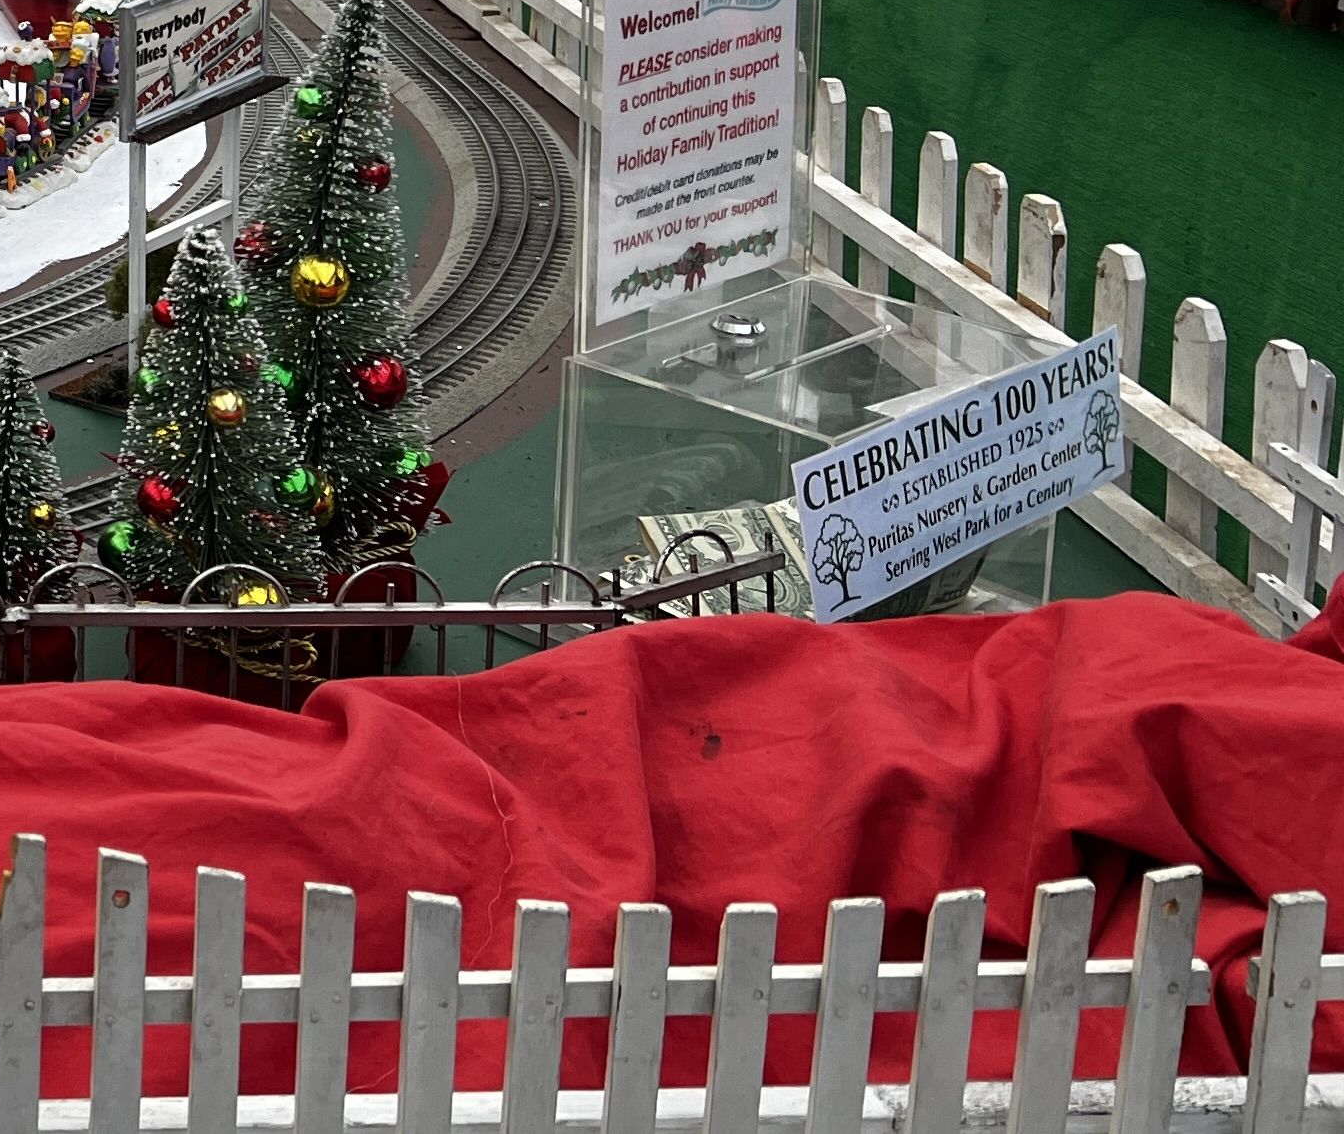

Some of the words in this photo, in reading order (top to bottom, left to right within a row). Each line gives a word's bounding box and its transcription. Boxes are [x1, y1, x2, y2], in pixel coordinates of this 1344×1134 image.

[136, 7, 207, 47] Everybody
[620, 0, 701, 39] Welcome!
[136, 43, 167, 67] likes
[206, 30, 262, 86] PAYDA
[618, 51, 673, 84] PLEASE
[675, 36, 733, 66] consider
[735, 25, 782, 50] making
[620, 98, 628, 113] a
[632, 73, 710, 110] contribution
[714, 69, 726, 86] in
[729, 52, 780, 81] support
[617, 143, 668, 174] Holiday
[671, 129, 715, 157] Family
[717, 109, 780, 143] Tradition!
[643, 116, 656, 136] of
[659, 99, 728, 131] continuing
[732, 89, 756, 110] this
[614, 179, 672, 208] Credit/debit
[673, 171, 695, 189] card
[696, 157, 742, 181] donations
[744, 151, 765, 168] may
[766, 147, 779, 160] be
[636, 200, 663, 220] made
[664, 196, 675, 210] at
[676, 189, 691, 207] the
[693, 184, 716, 202] front
[717, 173, 756, 194] counter.
[613, 230, 654, 255] THANK
[657, 218, 682, 240] YOU
[685, 214, 701, 231] for
[703, 207, 728, 228] your
[731, 190, 778, 217] support!
[803, 400, 983, 511] CELEBRATING
[991, 379, 1036, 427] 100
[1040, 339, 1116, 404] YEARS!
[902, 443, 1002, 505] ESTABLISHED
[1007, 421, 1044, 456] 1925
[867, 523, 915, 557] Puritas
[917, 495, 969, 533] Nursery
[972, 484, 984, 504] &
[986, 463, 1037, 498] Garden
[1040, 440, 1083, 473] Center
[886, 547, 931, 582] Serving
[933, 527, 962, 554] West
[965, 512, 991, 540] Park
[994, 503, 1014, 527] for
[1015, 498, 1024, 514] a
[1026, 475, 1076, 510] Century
